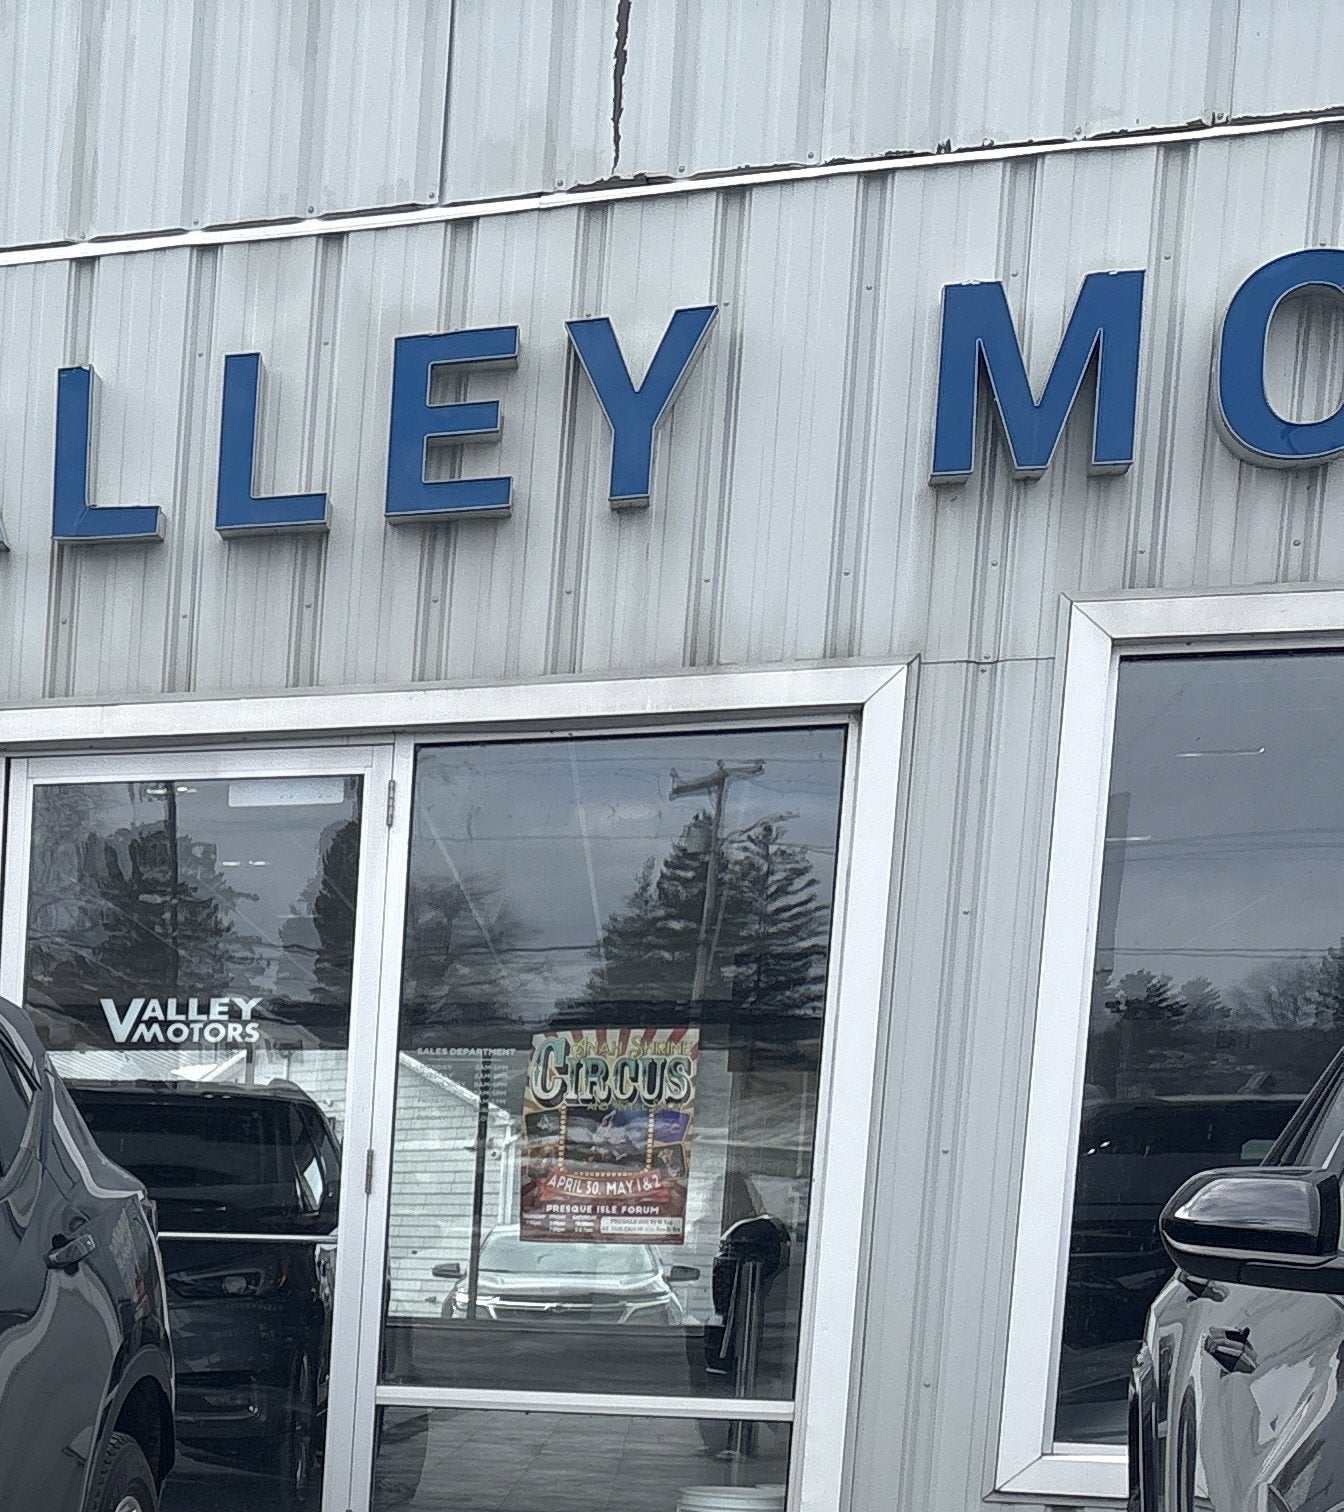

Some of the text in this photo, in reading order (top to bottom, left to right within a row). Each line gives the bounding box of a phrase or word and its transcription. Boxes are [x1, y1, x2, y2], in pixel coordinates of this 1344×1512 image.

[100, 997, 262, 1043] VALLEY
[130, 1022, 260, 1043] MOTORS
[417, 1047, 517, 1057] SALES DEPARTMENT
[531, 1036, 692, 1104] CIRCUS
[548, 1174, 583, 1194] APRIL
[606, 1179, 633, 1195] MAY
[545, 1204, 660, 1215] PRESQUE ISLE FORUM
